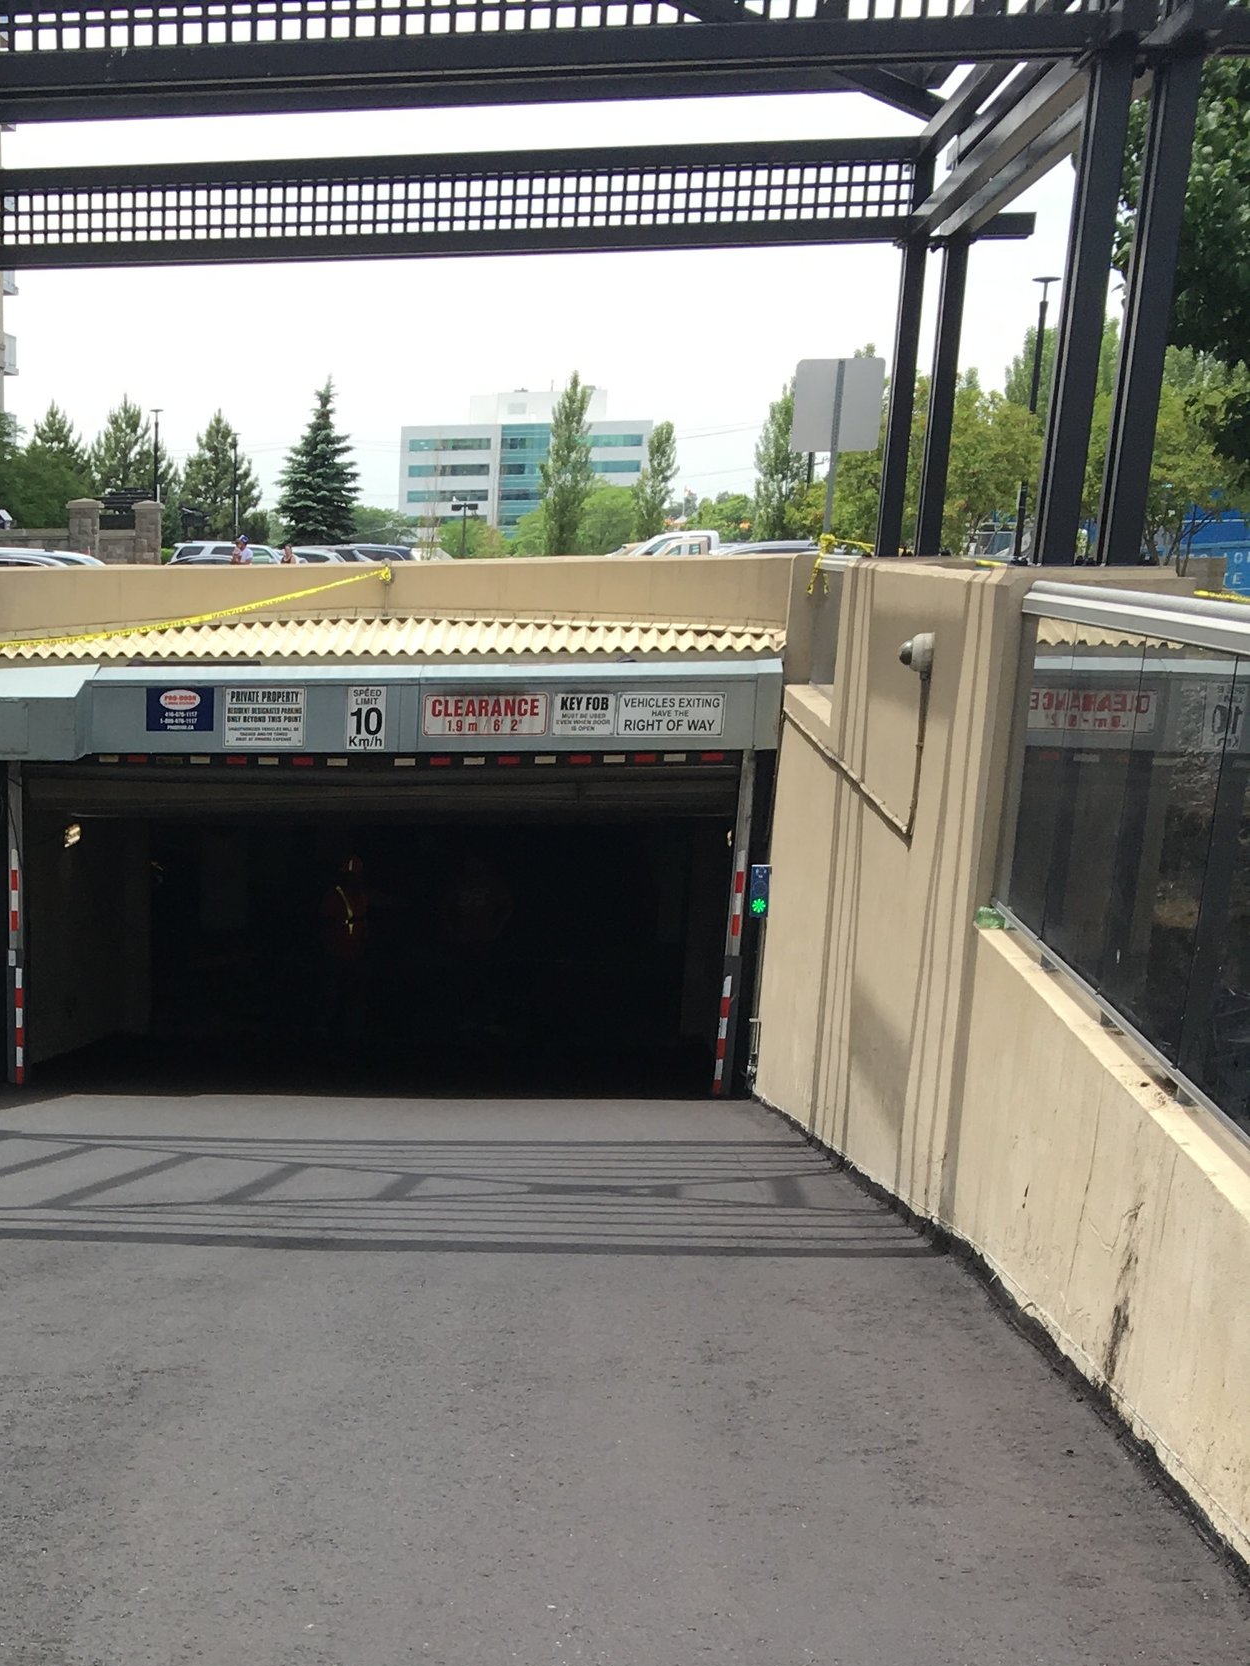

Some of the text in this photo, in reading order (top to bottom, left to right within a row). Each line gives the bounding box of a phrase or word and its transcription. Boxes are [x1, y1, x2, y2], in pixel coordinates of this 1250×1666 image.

[230, 690, 300, 703] PRIVATE PROPERTY
[353, 689, 382, 697] SPEED
[355, 697, 379, 705] LIMIT
[560, 696, 609, 711] KEY FOB
[623, 697, 720, 708] VEHICLES EXITING
[431, 698, 539, 718] CLEARANCE
[651, 709, 690, 717] HAVE THE
[226, 715, 302, 723] ONLY BEYOND THIS POINT
[350, 707, 383, 736] 10
[623, 719, 715, 731] RIGHT OF WAY
[447, 719, 463, 732] 1.9
[468, 721, 478, 732] m
[349, 735, 383, 747] Km/h
